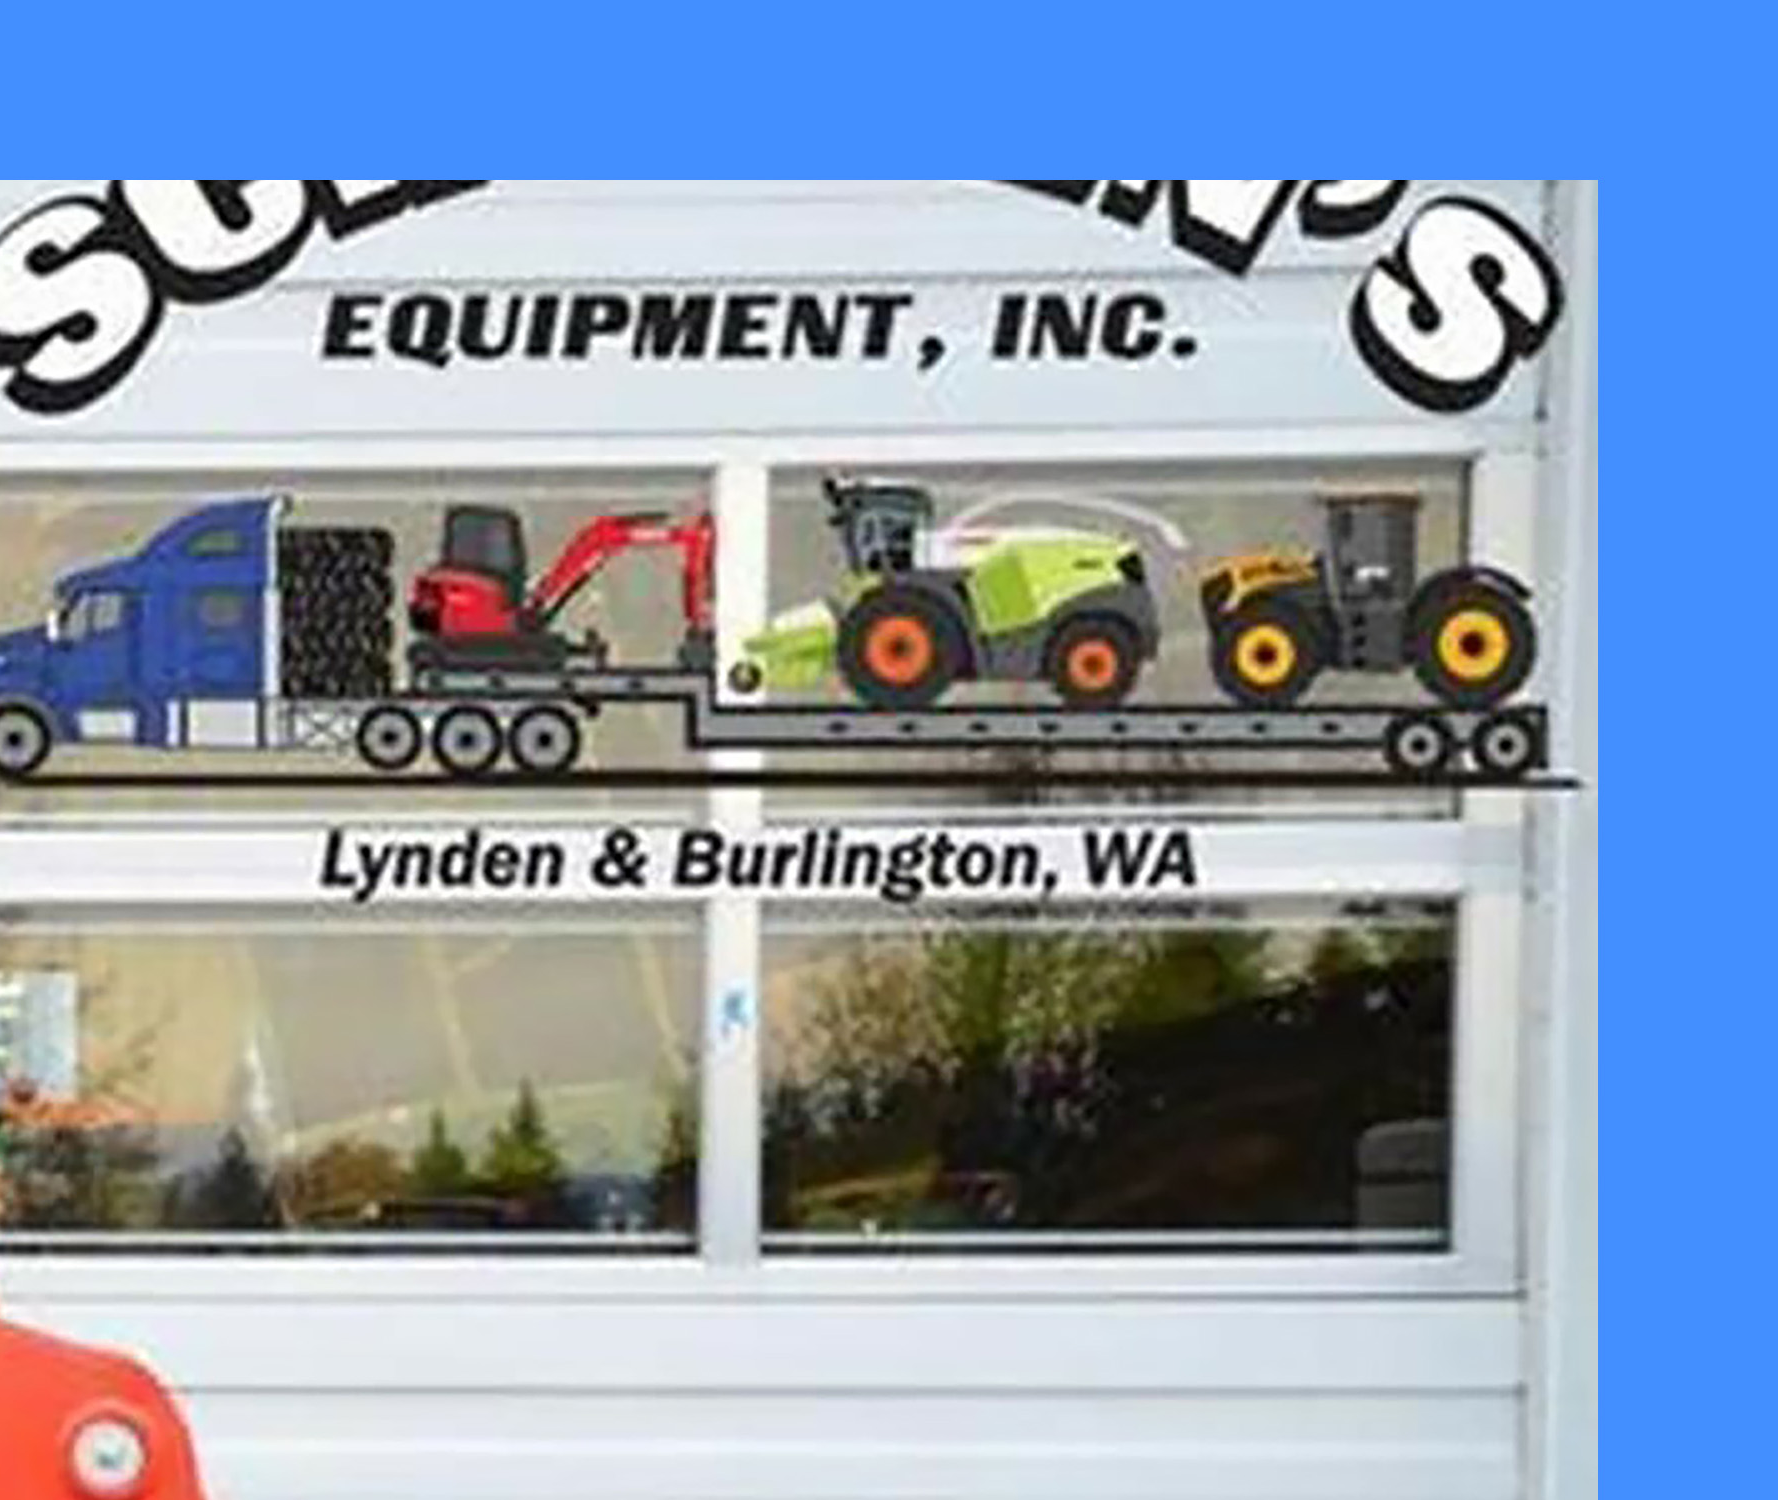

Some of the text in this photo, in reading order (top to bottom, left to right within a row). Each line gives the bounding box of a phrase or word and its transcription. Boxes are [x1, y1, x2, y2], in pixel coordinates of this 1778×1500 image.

[321, 293, 1198, 369] EQUIPMENT, INC.
[320, 829, 1198, 904] Lynden & Burlington, WA
